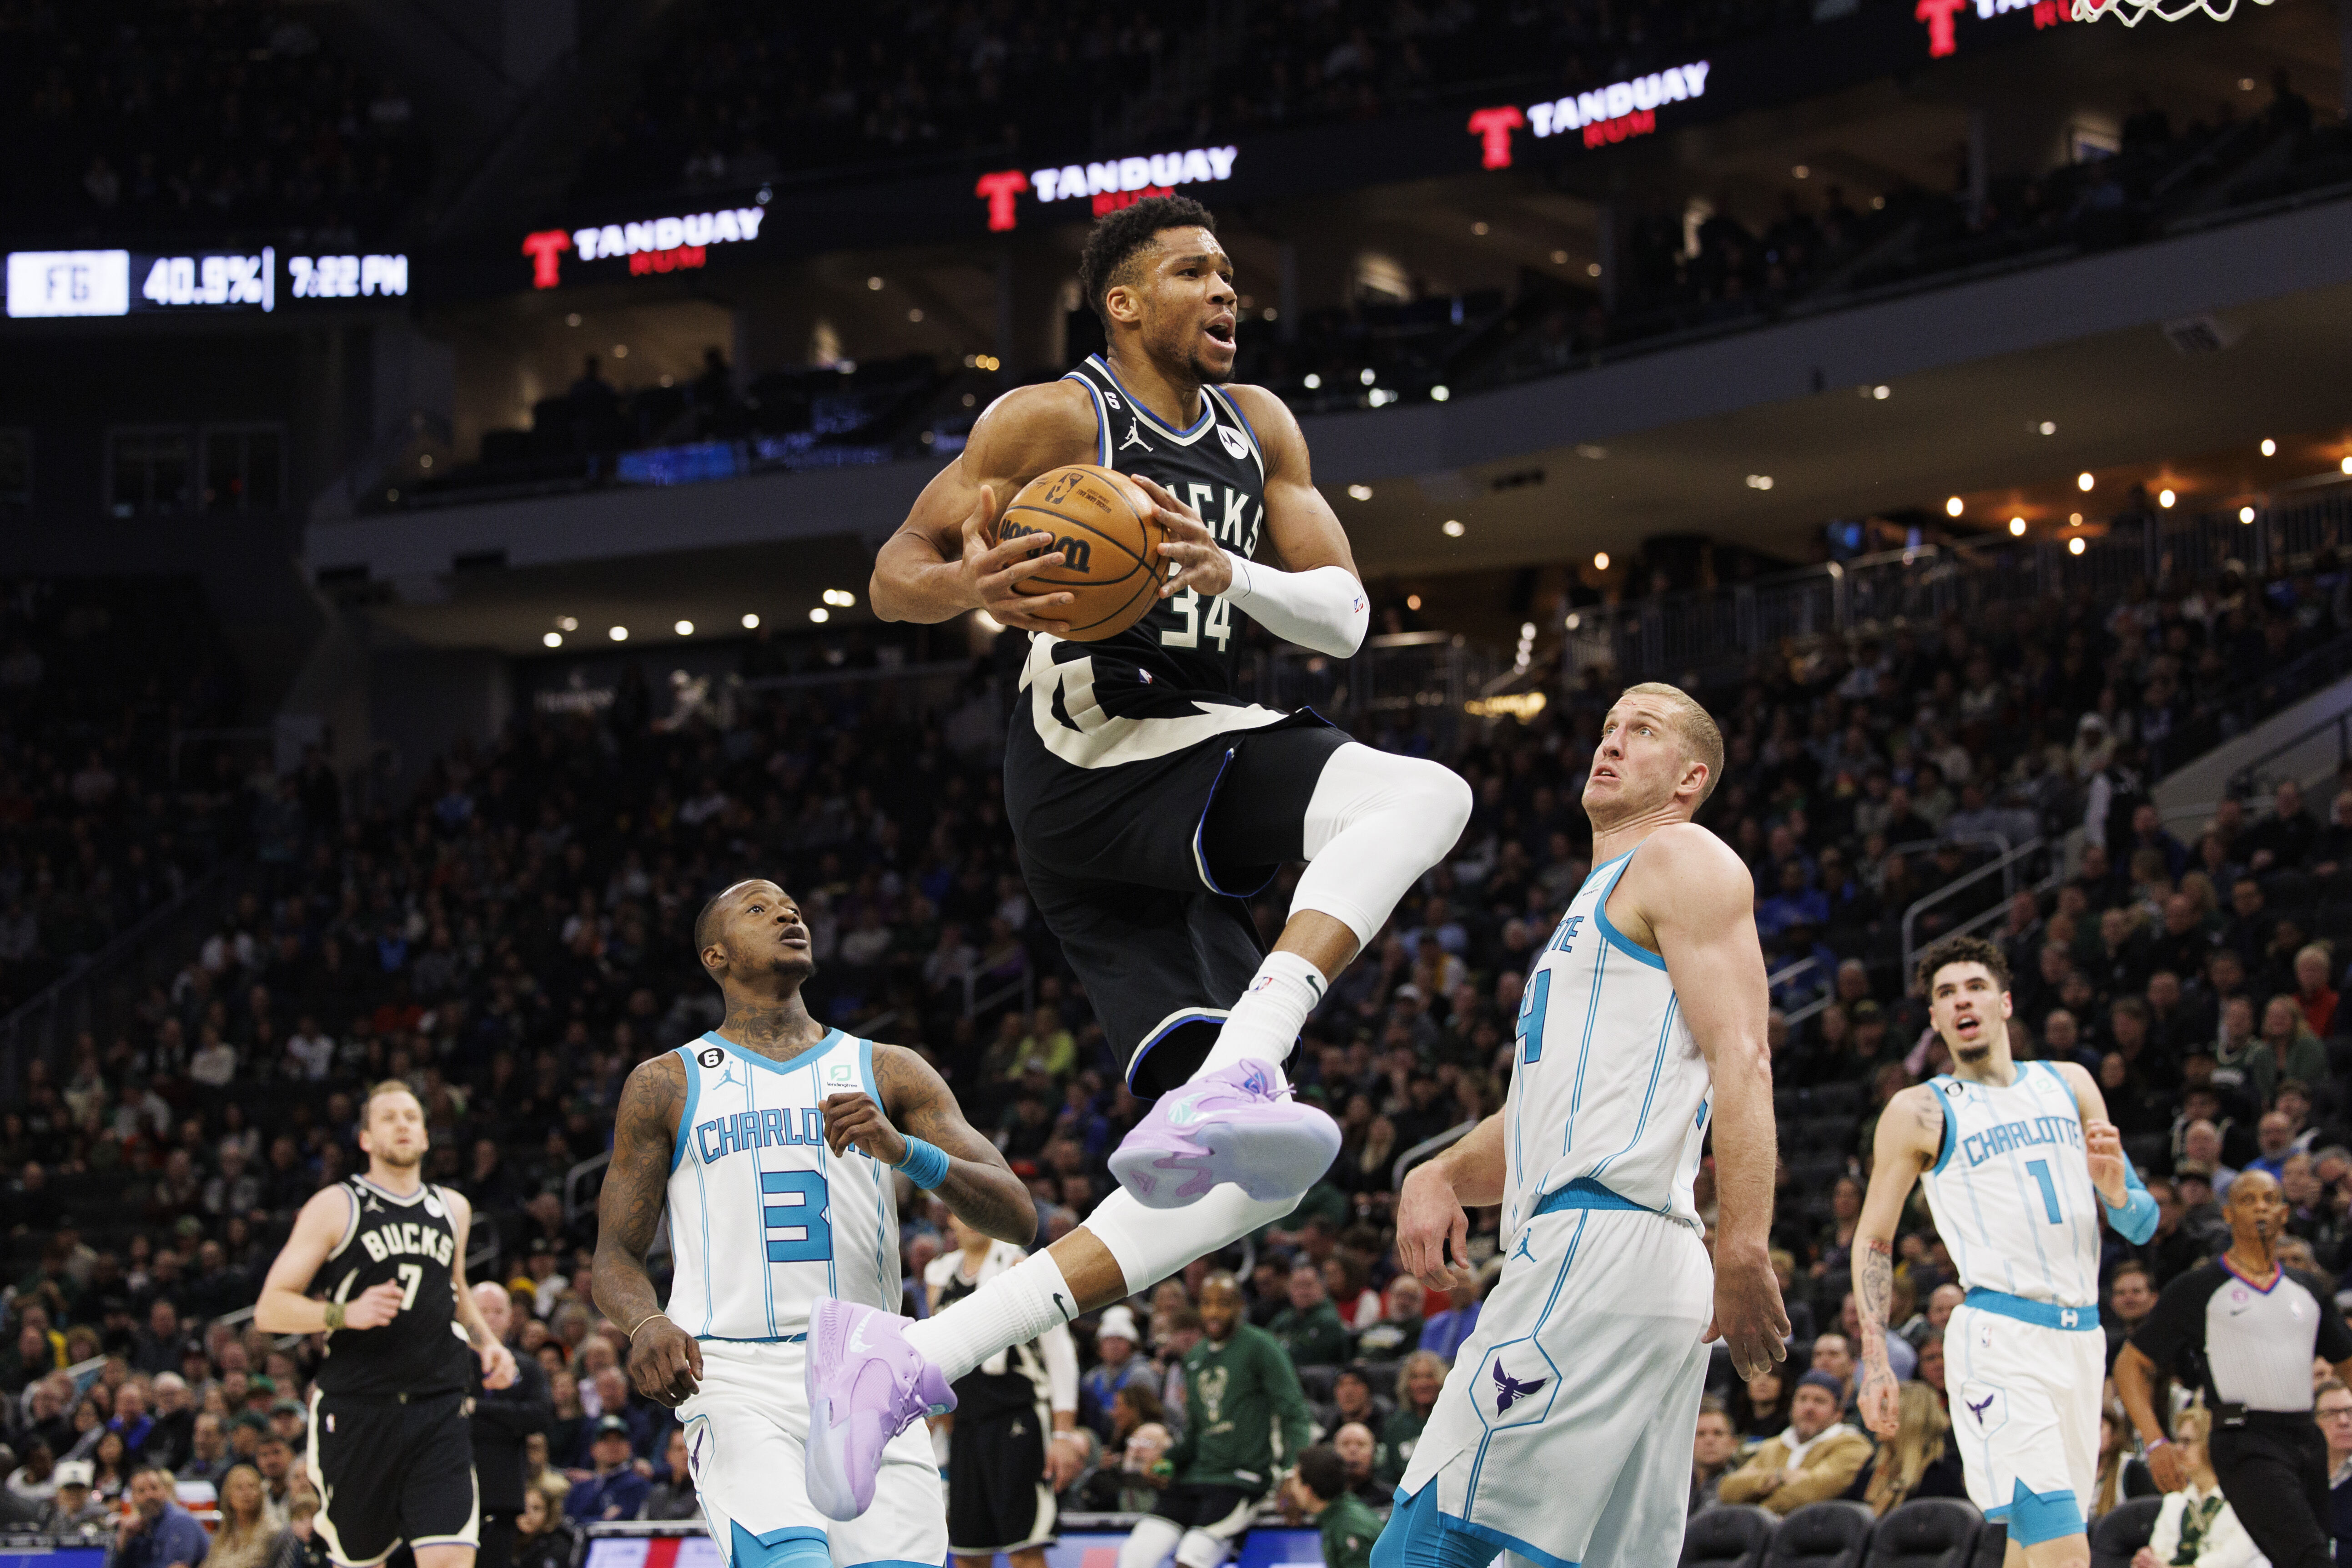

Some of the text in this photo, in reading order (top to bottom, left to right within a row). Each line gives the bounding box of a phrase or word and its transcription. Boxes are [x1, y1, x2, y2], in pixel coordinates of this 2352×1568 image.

[1527, 60, 1709, 138] TANDUAY
[1583, 108, 1656, 149] RUM
[1030, 145, 1237, 203] TANDUAY
[573, 206, 764, 261] TANDUAY
[46, 265, 90, 301] FG
[142, 256, 262, 305] 40.9%
[288, 254, 408, 298] 7:22 PM
[629, 244, 706, 276] RUM
[1104, 391, 1121, 410] 6
[1165, 481, 1264, 560] CKS
[1159, 561, 1232, 655] 34
[704, 1050, 719, 1066] 6
[696, 1107, 872, 1165] CHARLO
[1962, 1116, 2081, 1167] CHARLOTTE
[760, 1170, 832, 1263] 3
[2025, 1159, 2063, 1225] 1
[360, 1222, 454, 1268] BUCKS
[398, 1262, 422, 1311] 7
[2061, 1308, 2079, 1328] H
